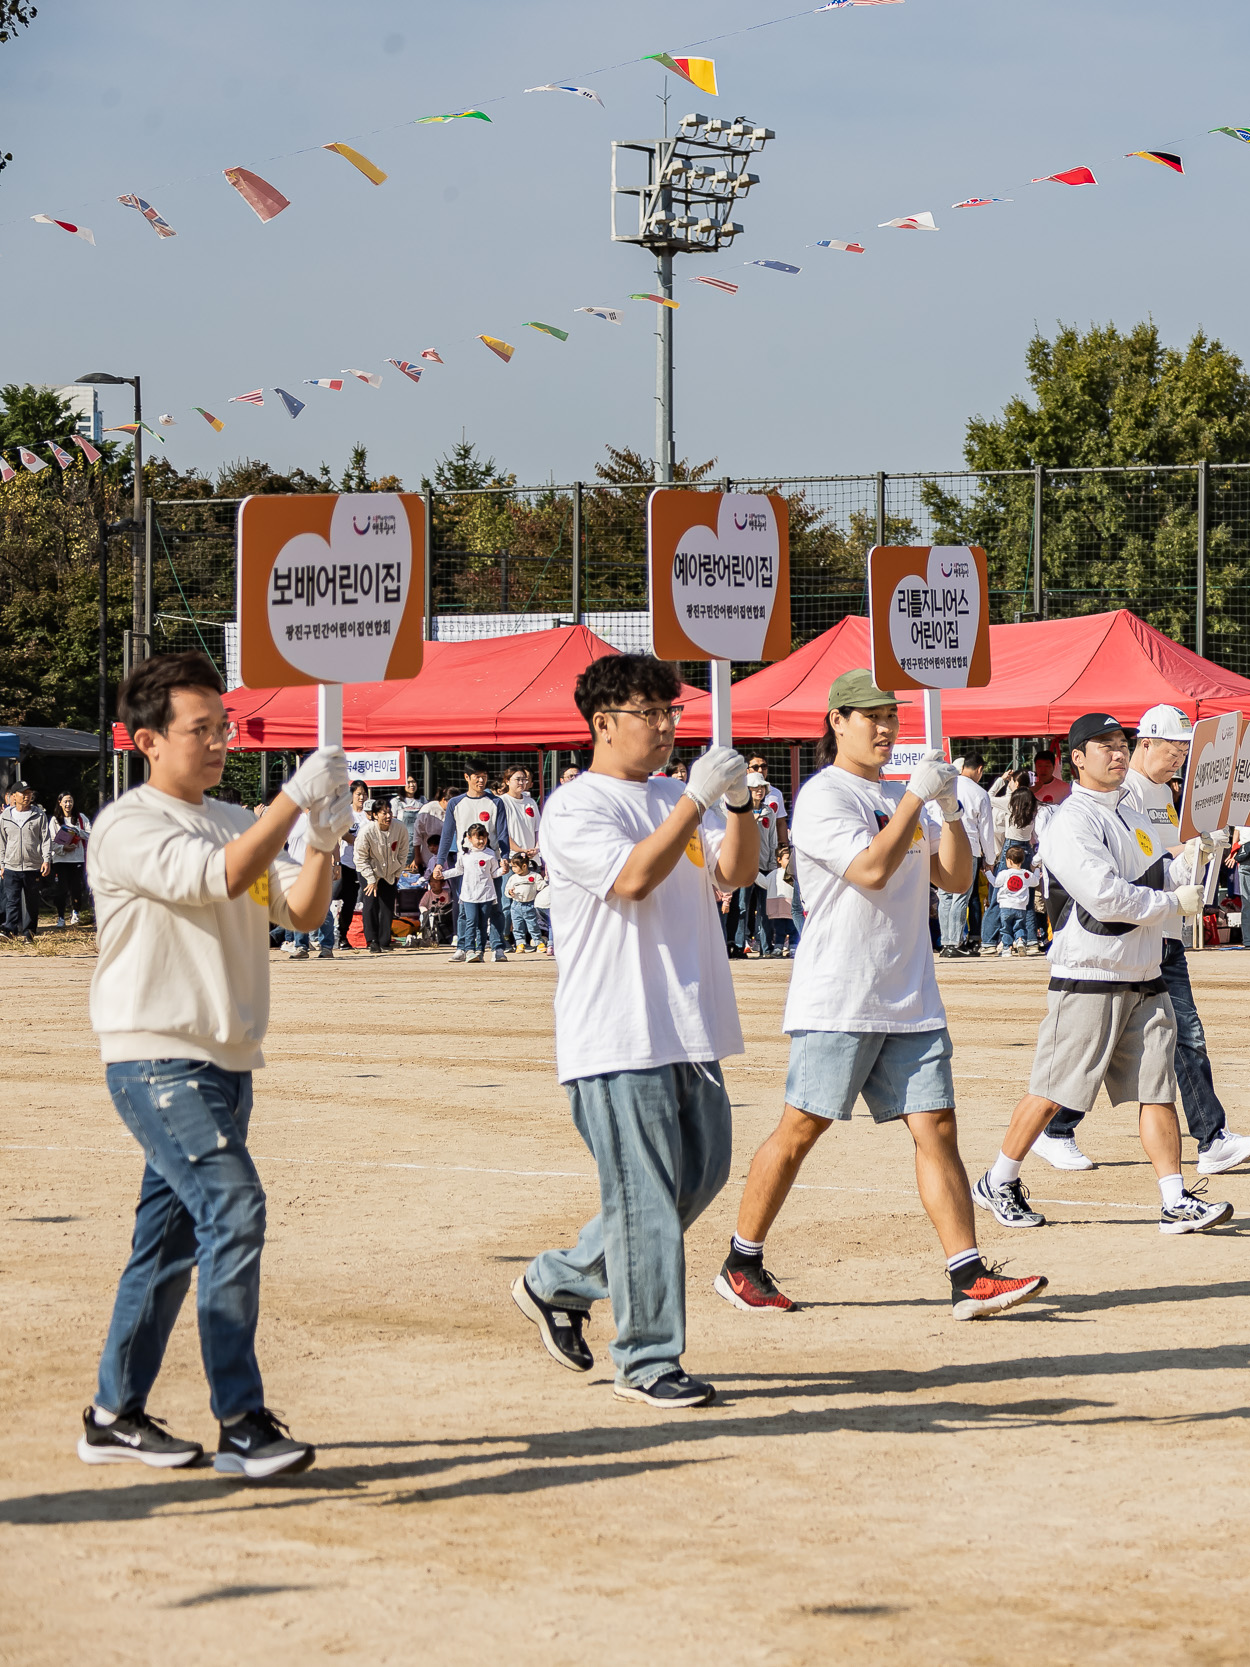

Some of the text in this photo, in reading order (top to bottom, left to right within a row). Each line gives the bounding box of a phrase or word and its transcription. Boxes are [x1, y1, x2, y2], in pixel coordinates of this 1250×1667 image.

[674, 552, 773, 588] 예아랑어린이집
[271, 562, 401, 607] 보배어린이집
[686, 603, 766, 620] 광진구민간어린이집연합회
[897, 588, 970, 619] 리틀지니어스
[285, 619, 391, 641] 광진구민간어린이집연합회
[911, 620, 959, 650] 어린이집
[900, 656, 968, 671] 광진구민간어린이집연합회
[889, 752, 925, 766] 빌어린
